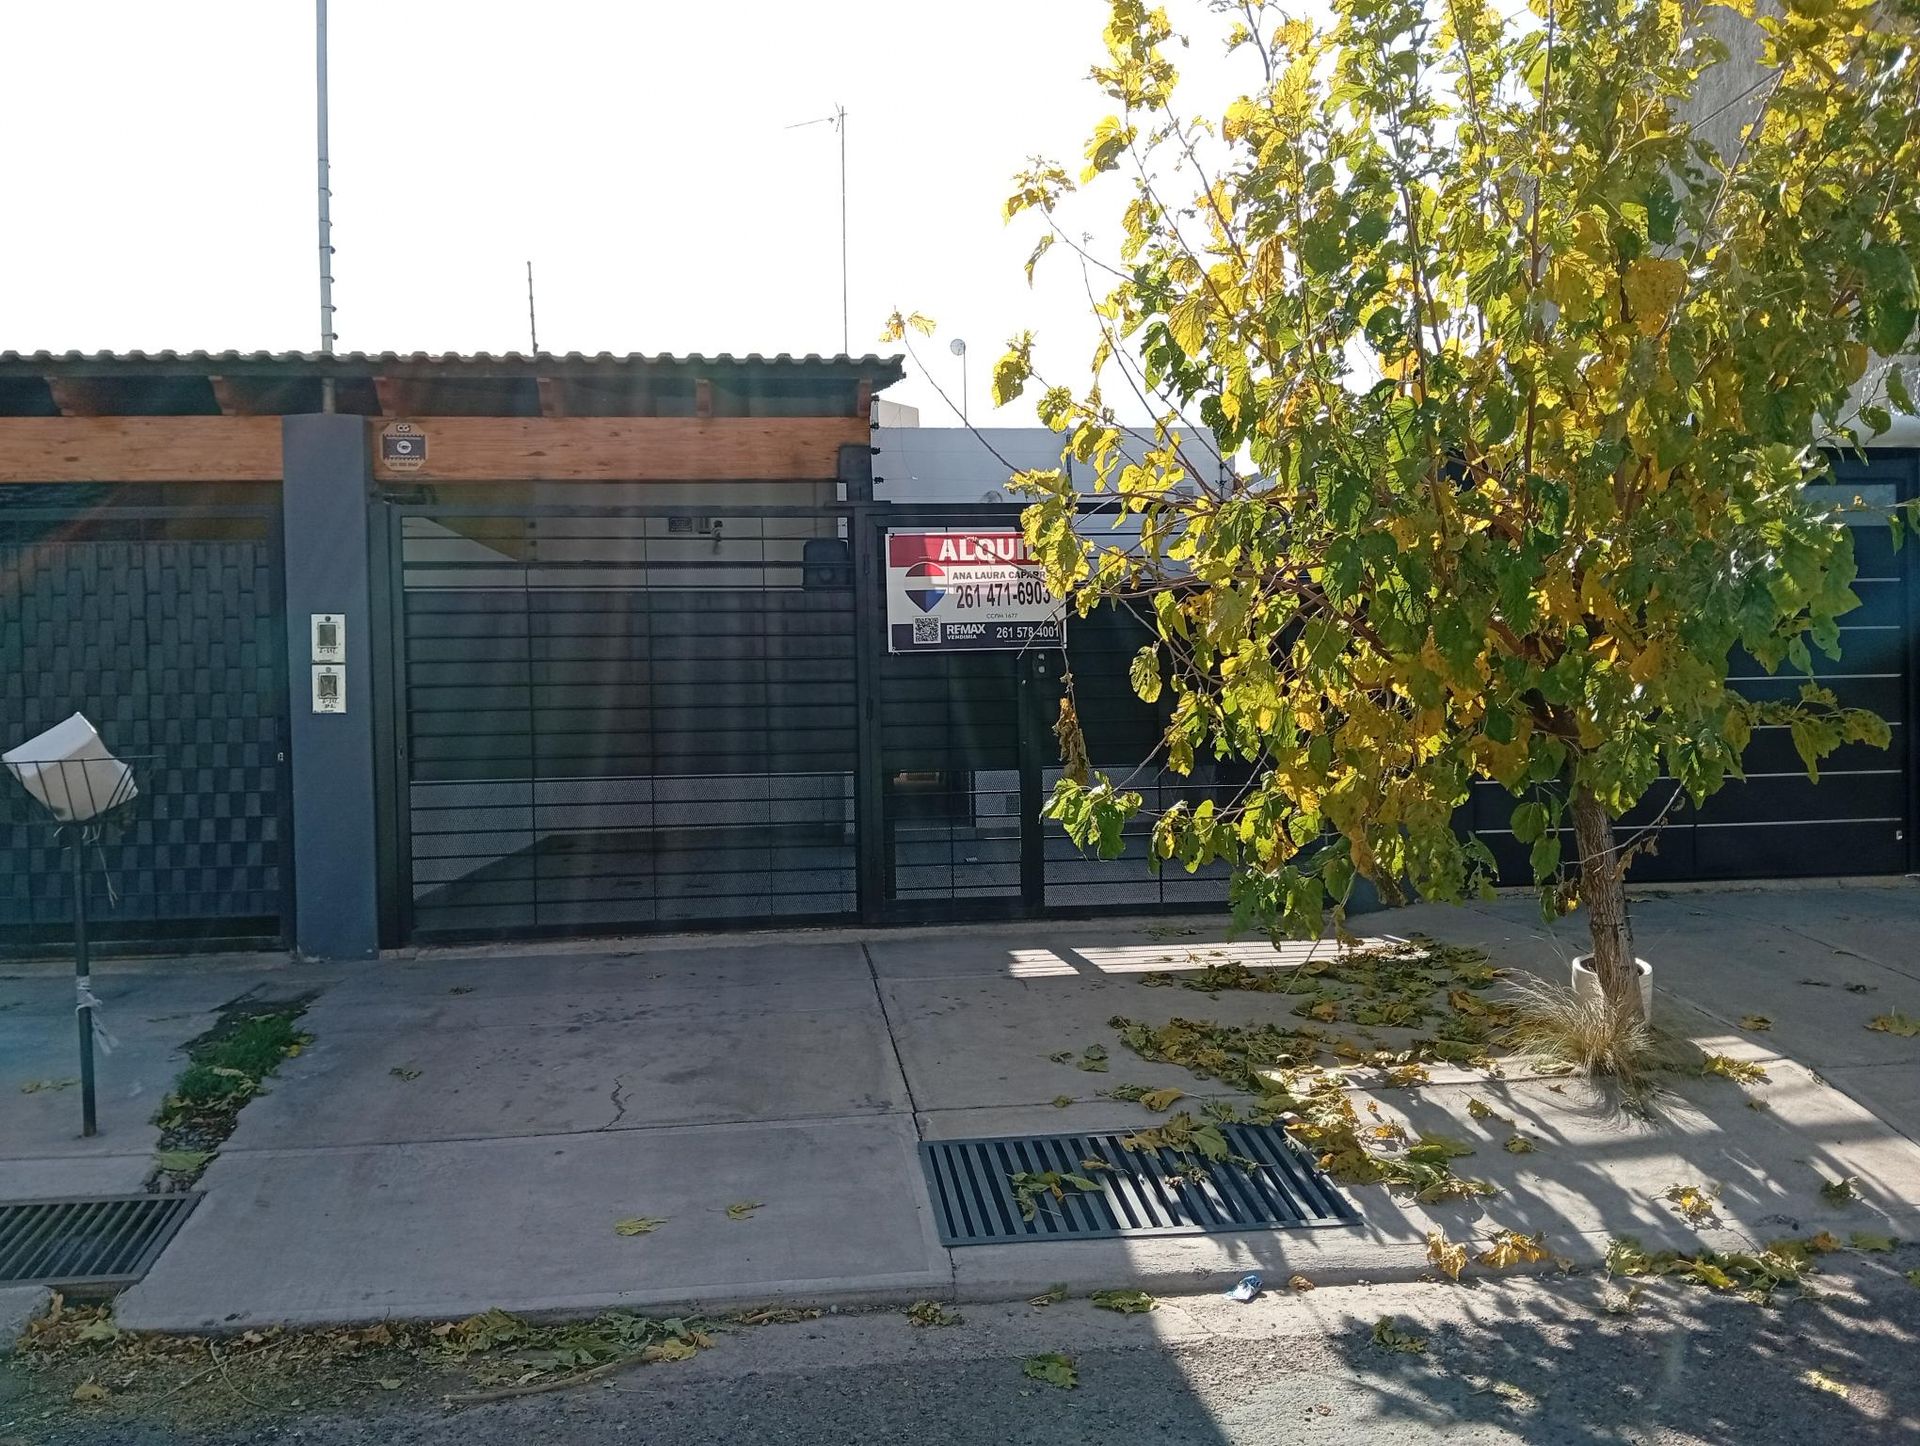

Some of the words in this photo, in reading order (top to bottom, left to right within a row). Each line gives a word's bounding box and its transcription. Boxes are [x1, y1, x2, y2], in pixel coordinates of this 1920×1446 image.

[952, 571, 974, 580] ANA
[975, 571, 1006, 580] LAURA
[1008, 570, 1046, 579] CAPARR
[956, 584, 981, 609] 261
[946, 623, 986, 635] REMAX
[996, 627, 1013, 638] 261
